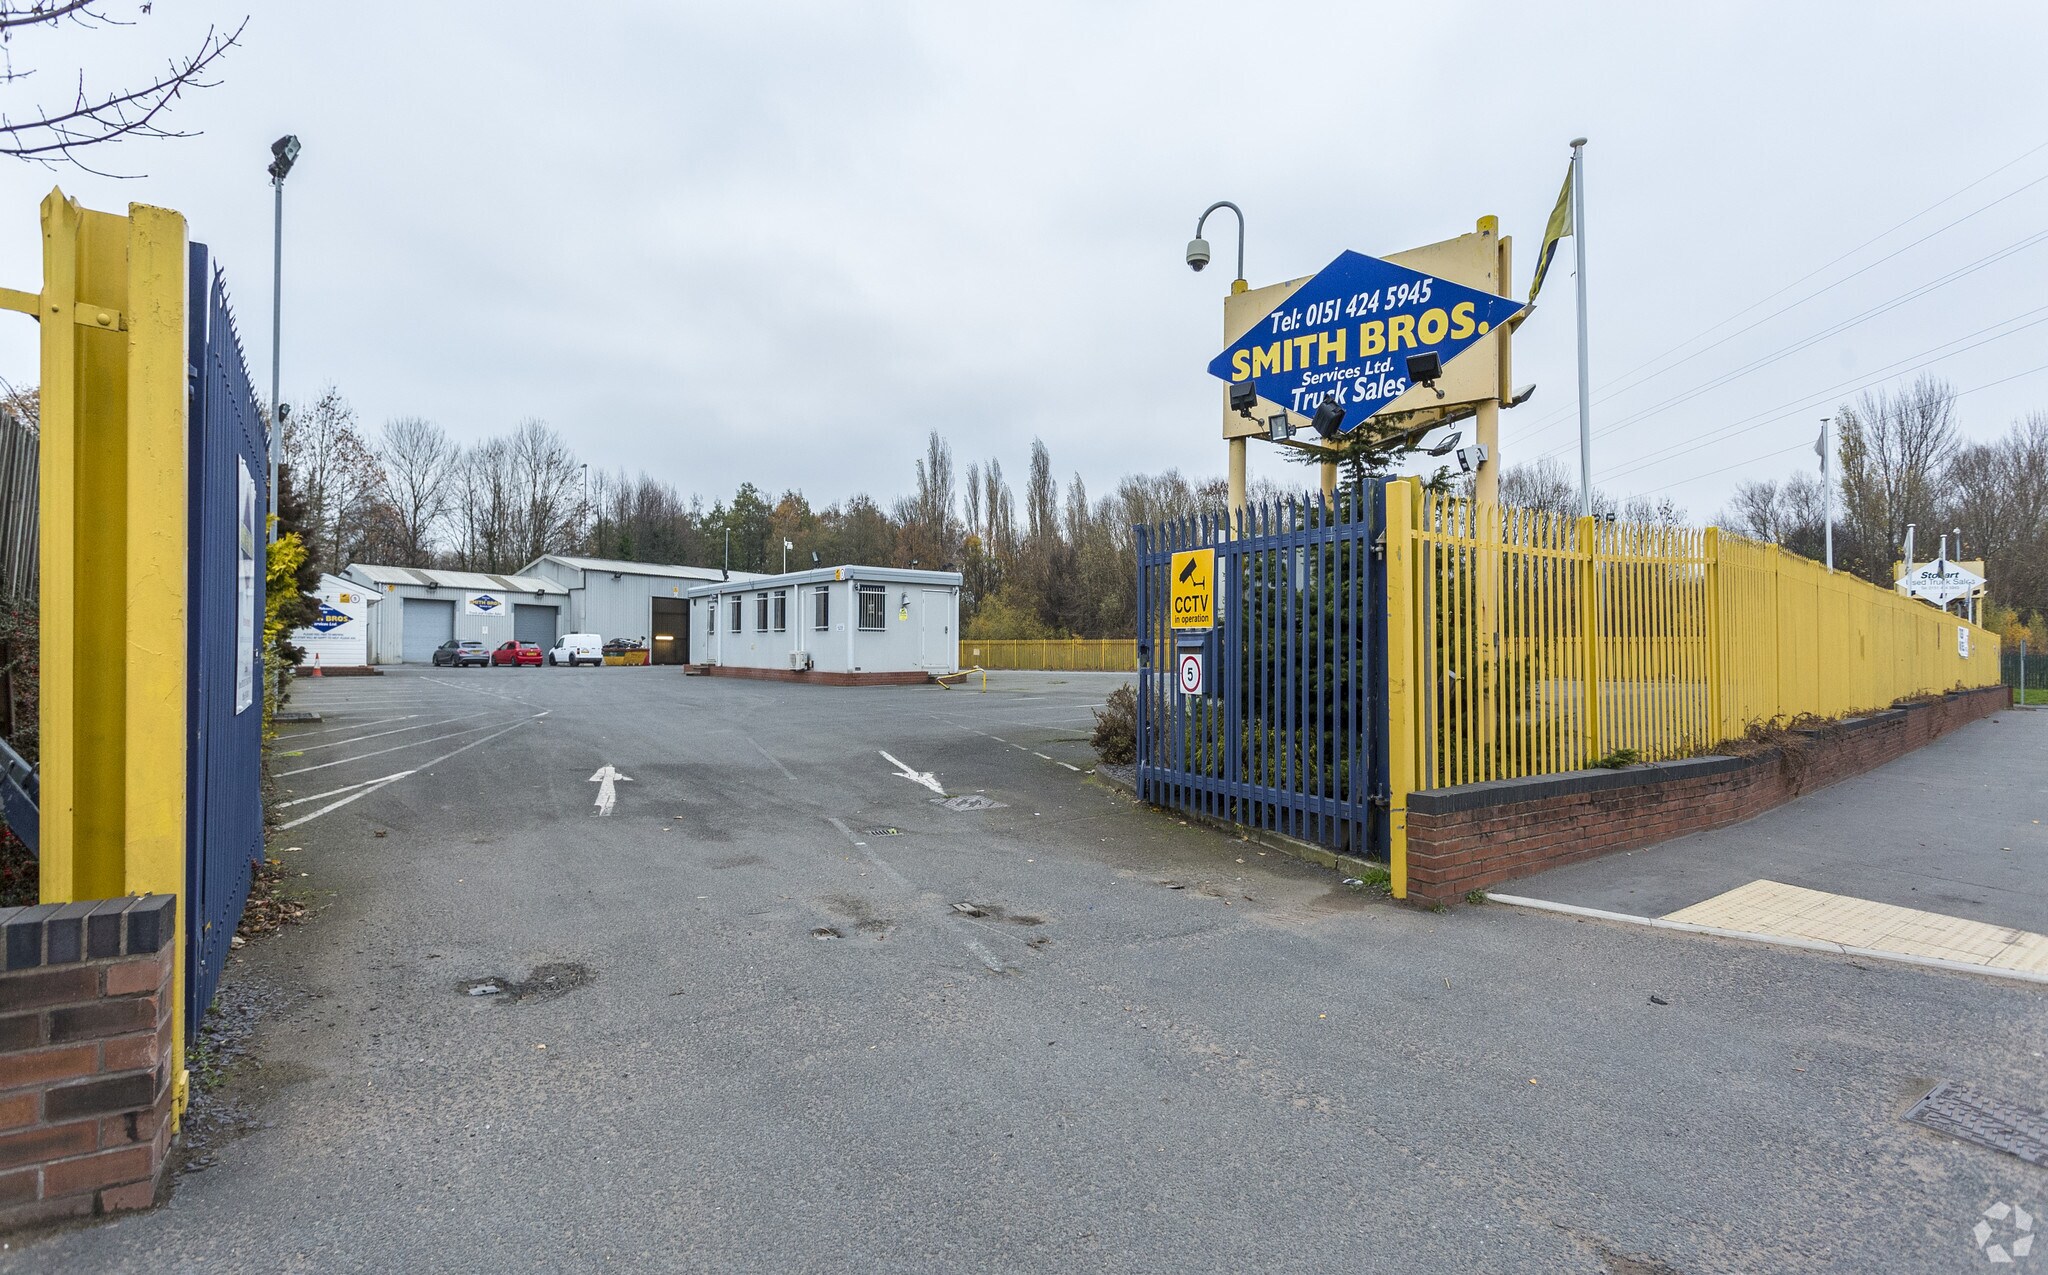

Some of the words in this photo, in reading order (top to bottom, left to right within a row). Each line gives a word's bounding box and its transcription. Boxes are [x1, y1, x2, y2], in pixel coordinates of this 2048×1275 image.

[1271, 311, 1302, 334] Tel:
[1306, 299, 1341, 326] 0151
[1345, 292, 1379, 318] 424
[1384, 278, 1433, 310] 5945
[1231, 327, 1347, 382] SMITH
[1359, 301, 1490, 358] BROS.
[1301, 366, 1360, 386] Services
[1365, 358, 1394, 375] Ltd.
[1352, 374, 1406, 403] Sales
[1921, 571, 1959, 579] Stoart
[1174, 594, 1208, 614] CCTV
[1175, 615, 1180, 623] in
[1181, 614, 1209, 625] operation
[1187, 667, 1193, 681] 5
